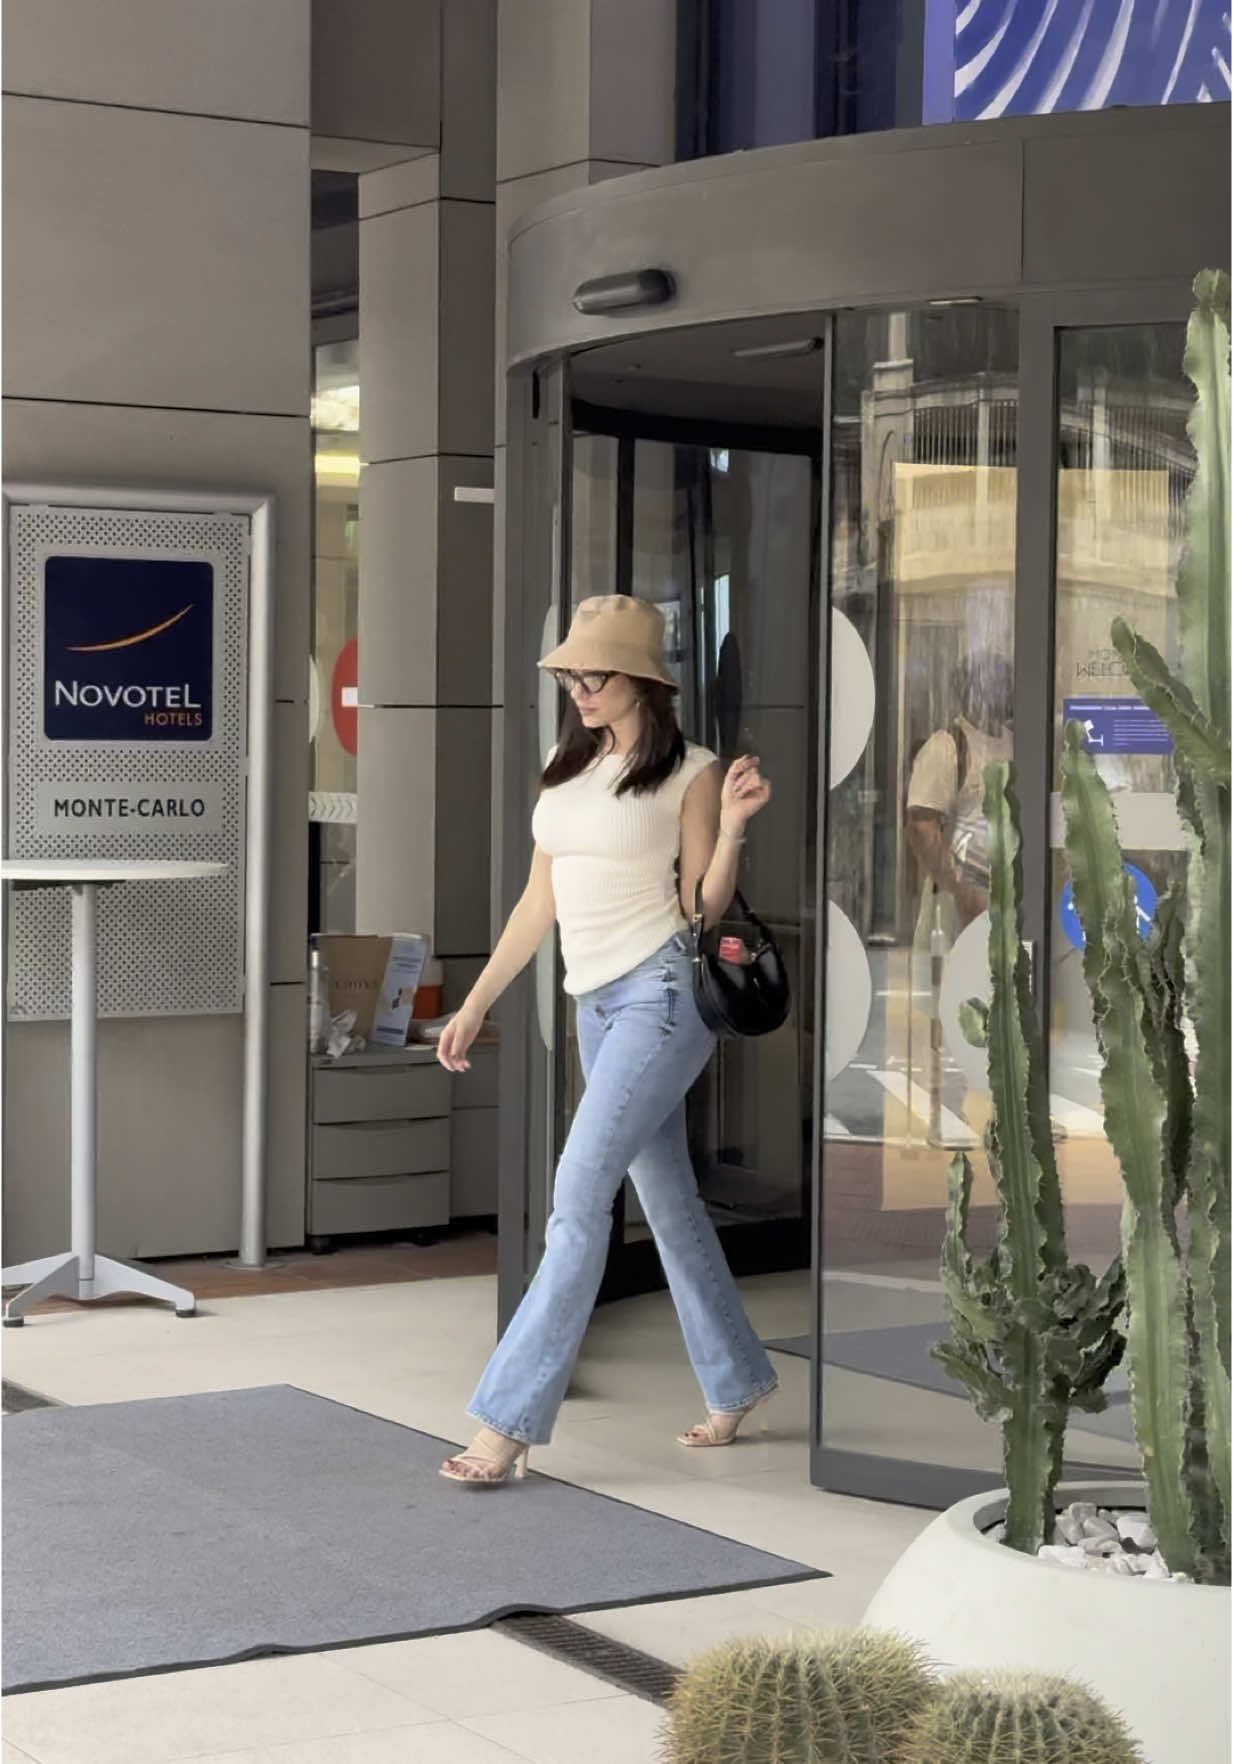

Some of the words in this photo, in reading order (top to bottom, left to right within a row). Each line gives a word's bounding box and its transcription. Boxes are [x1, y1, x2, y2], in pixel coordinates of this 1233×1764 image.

[55, 680, 201, 708] NOVOTEL
[144, 712, 203, 726] HOTELS
[54, 798, 205, 817] MONTE-CARLO
